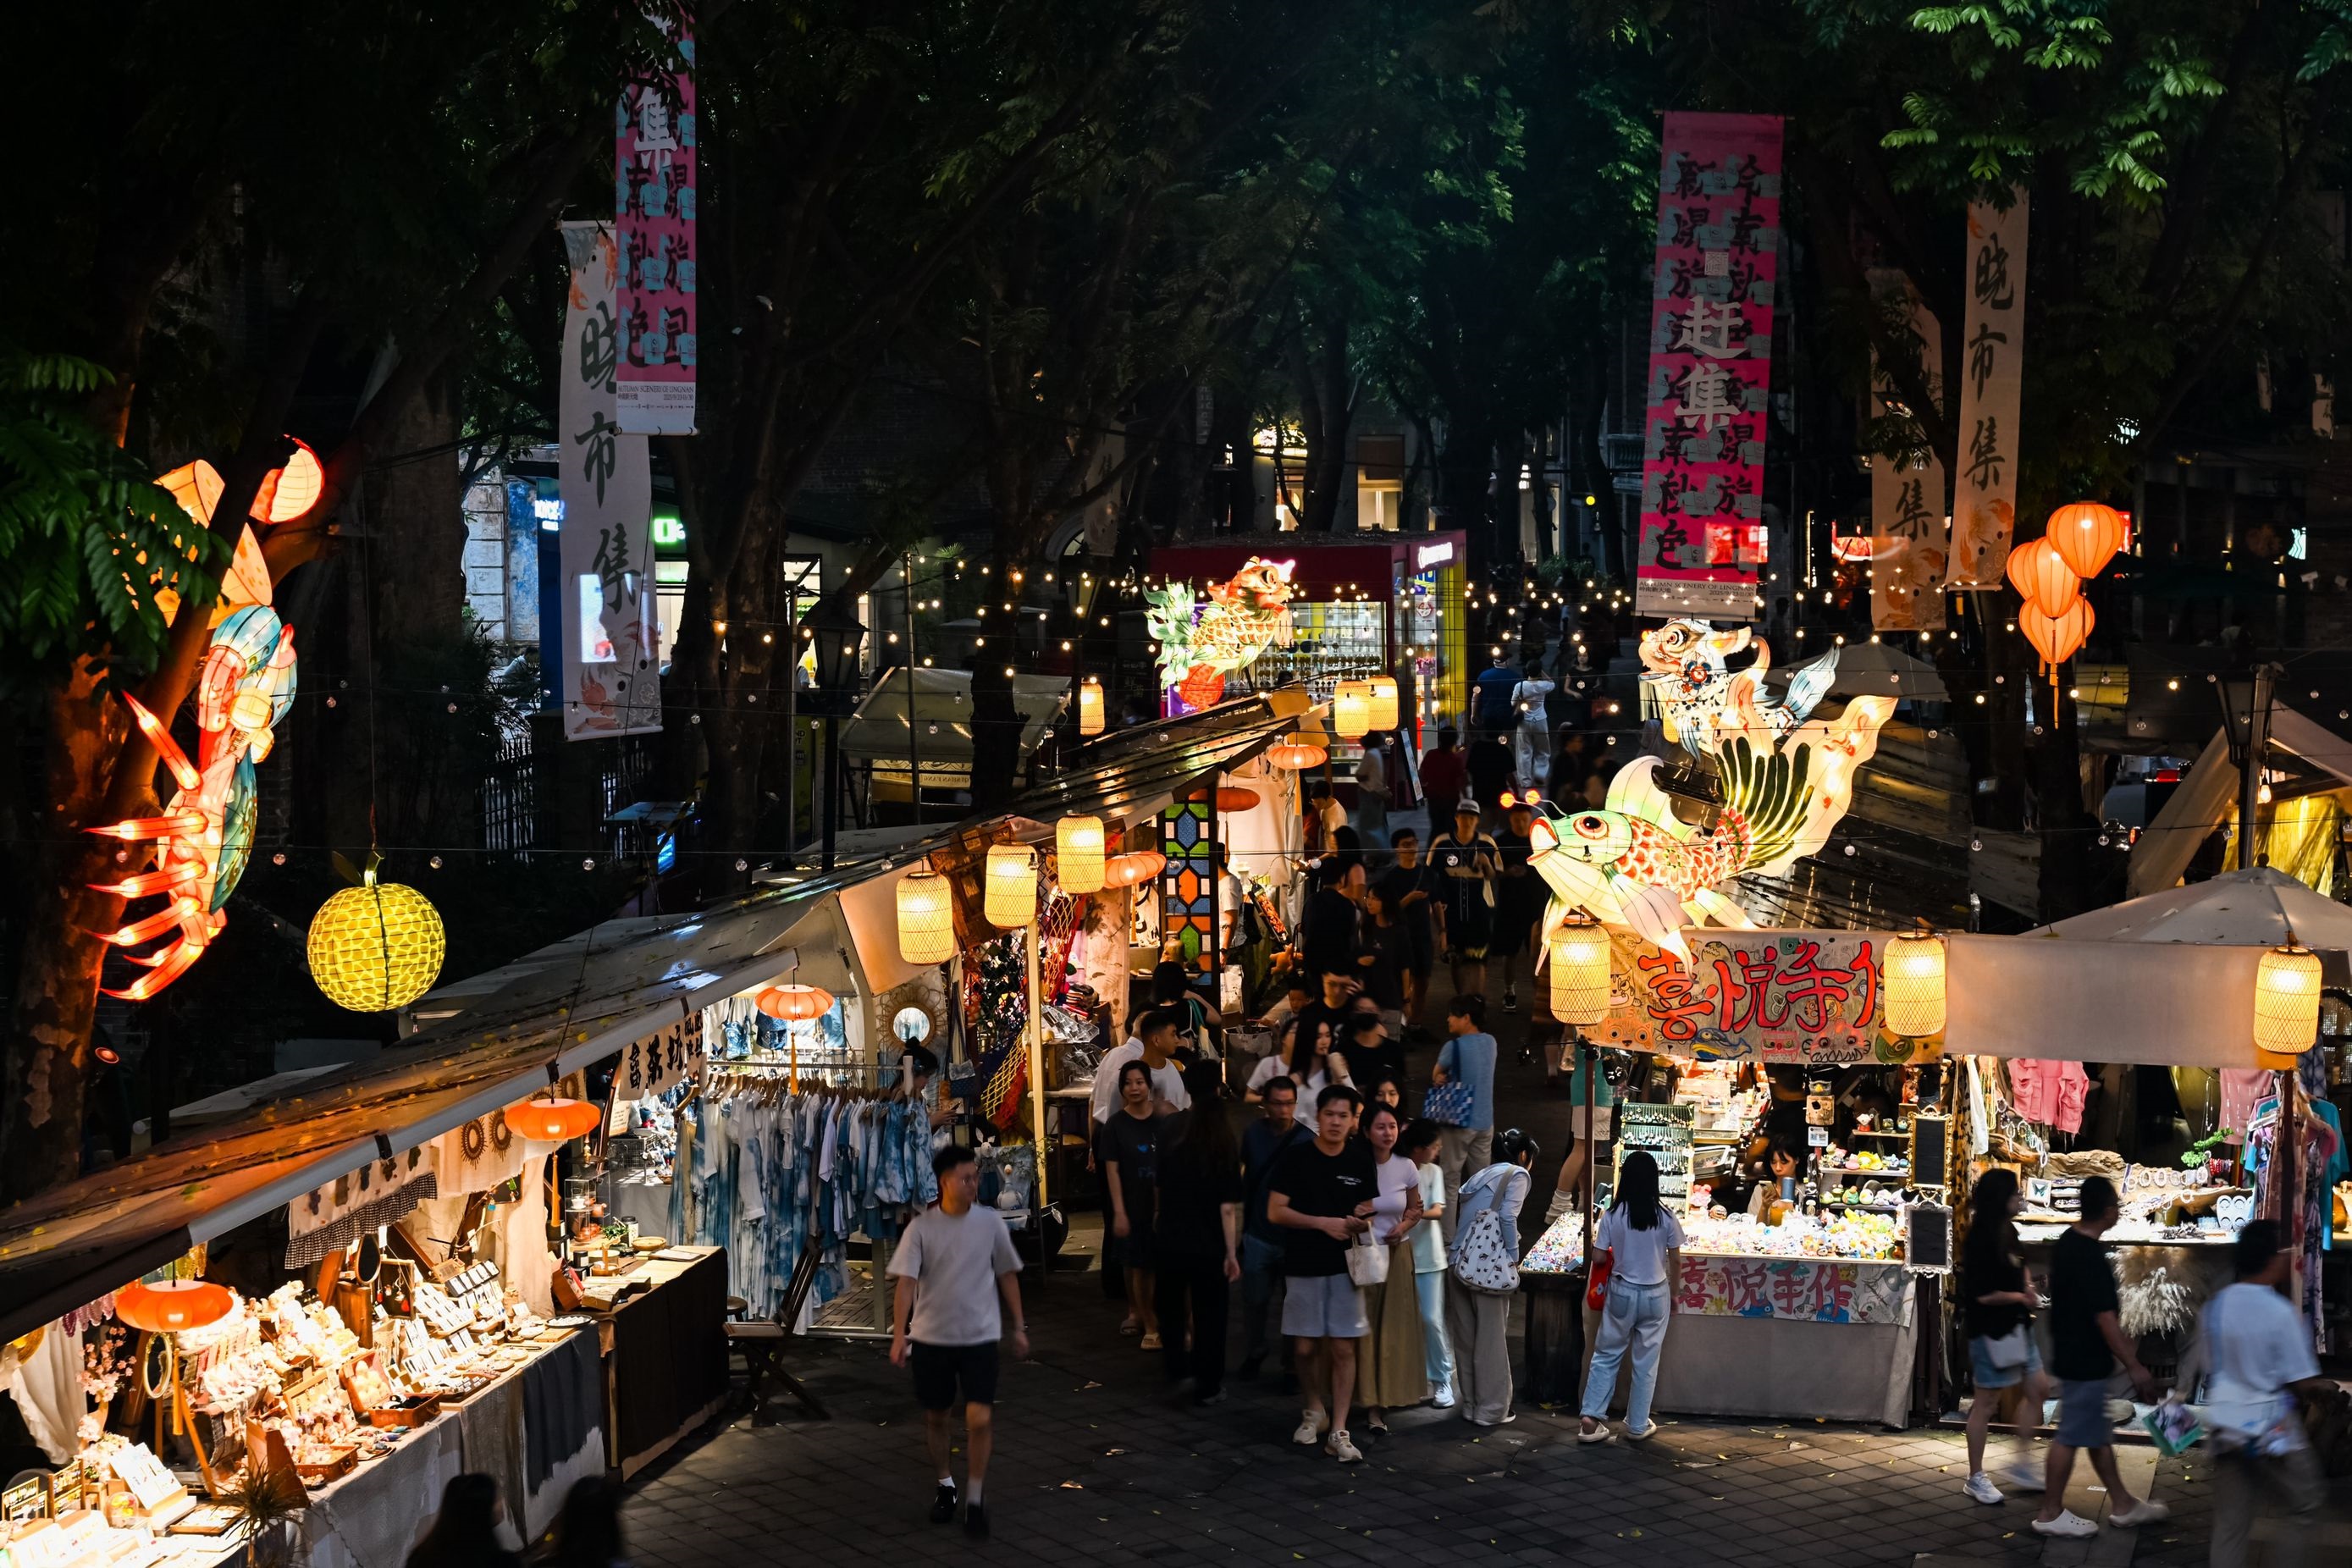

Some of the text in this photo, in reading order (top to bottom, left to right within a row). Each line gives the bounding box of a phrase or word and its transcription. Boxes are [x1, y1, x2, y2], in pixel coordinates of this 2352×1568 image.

[575, 301, 641, 615] 晓市集
[1672, 294, 1747, 433] 赶集
[1963, 232, 2013, 492] 晓市集
[1680, 1256, 1857, 1317] 喜悦手作
